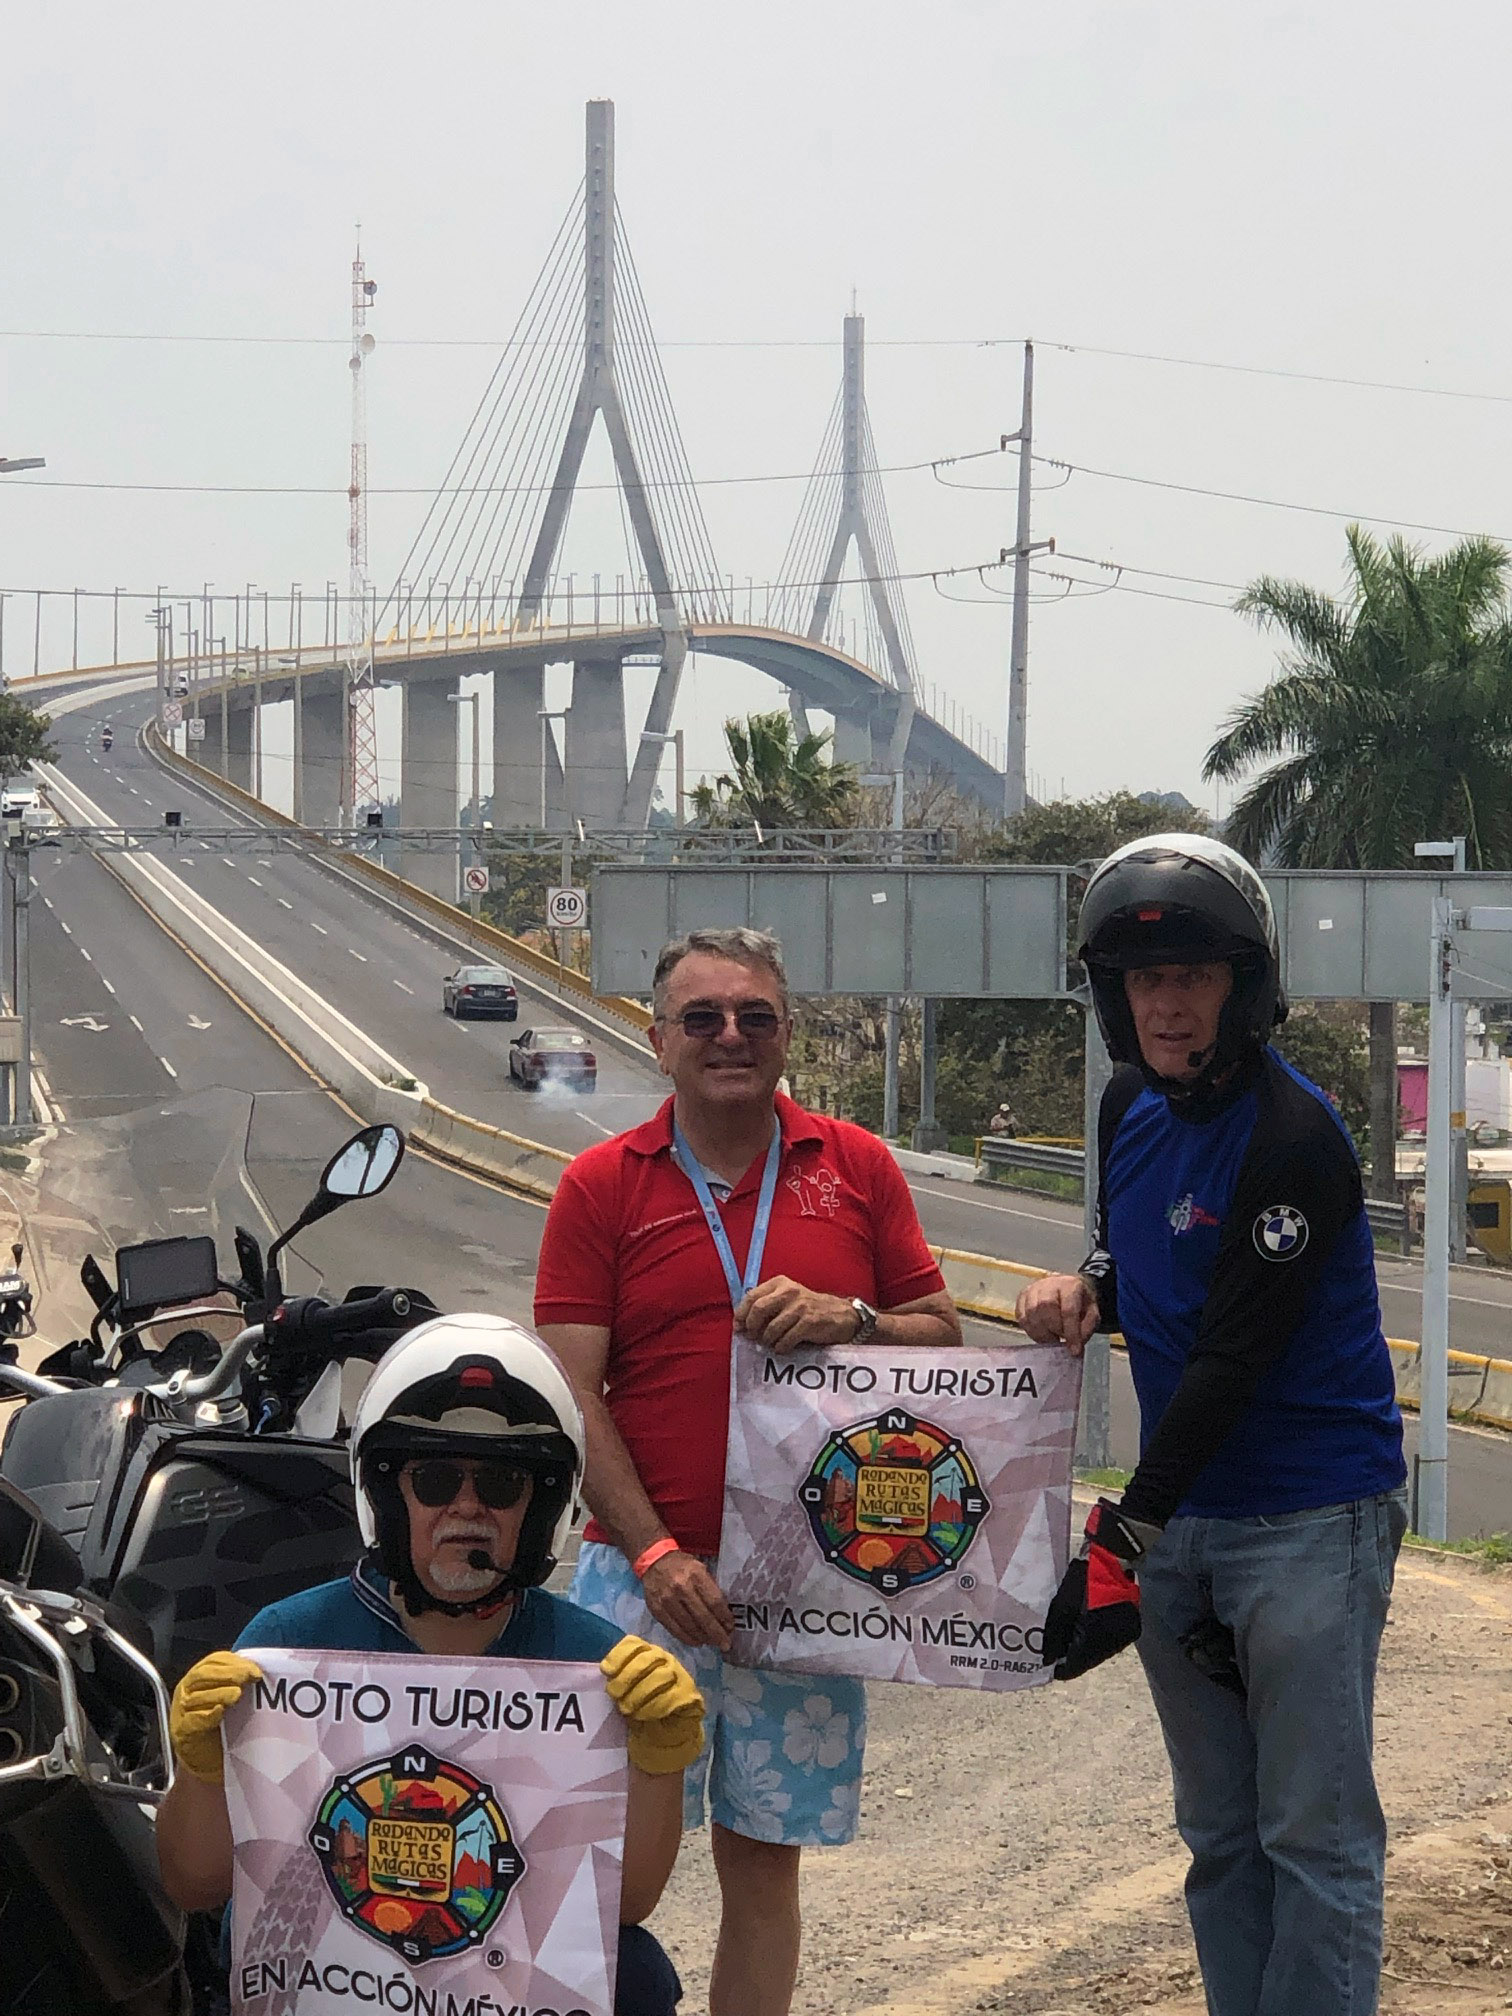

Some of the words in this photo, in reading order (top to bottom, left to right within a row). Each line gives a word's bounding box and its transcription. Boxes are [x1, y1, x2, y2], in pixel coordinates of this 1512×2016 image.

[556, 897, 578, 911] 80
[1261, 1207, 1305, 1227] BMW
[763, 1358, 877, 1393] MOTO
[889, 1368, 1038, 1398] TURISTA
[888, 1415, 906, 1429] N
[805, 1488, 821, 1501] O
[967, 1499, 982, 1512] E
[882, 1574, 898, 1588] S
[728, 1604, 769, 1631] EN
[779, 1606, 912, 1642] ACCIÓN
[921, 1612, 1044, 1655] MÉXICO
[950, 1655, 978, 1669] RRM
[255, 1678, 391, 1723] MOTO
[405, 1686, 585, 1733] TURISTA
[404, 1756, 426, 1772] N
[314, 1835, 330, 1852] O
[497, 1858, 515, 1874] E
[403, 1941, 420, 1956] S
[242, 1959, 286, 2000] EN
[297, 1959, 437, 2016] ACCIÓN
